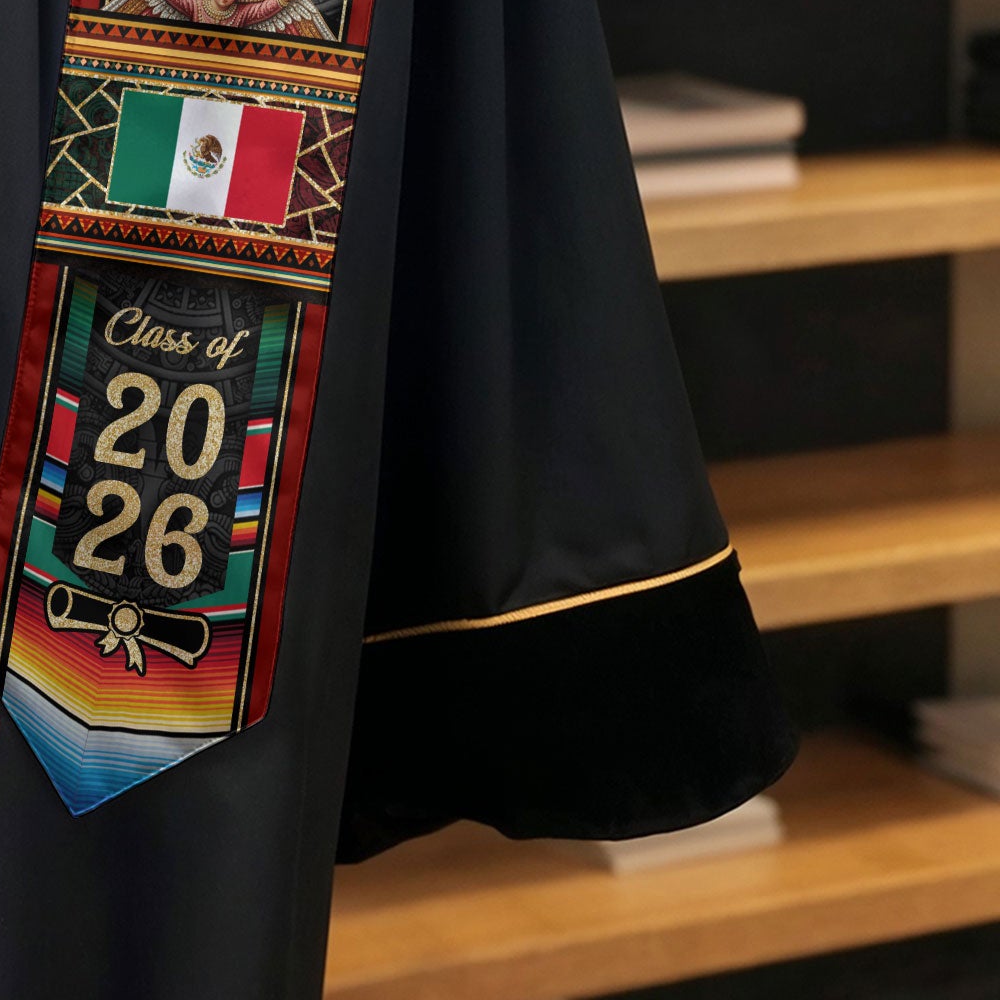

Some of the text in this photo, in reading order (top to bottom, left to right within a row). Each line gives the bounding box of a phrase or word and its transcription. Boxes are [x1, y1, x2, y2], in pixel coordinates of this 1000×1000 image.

[104, 307, 249, 370] Class of
[94, 372, 226, 480] 20
[72, 479, 209, 589] 26
